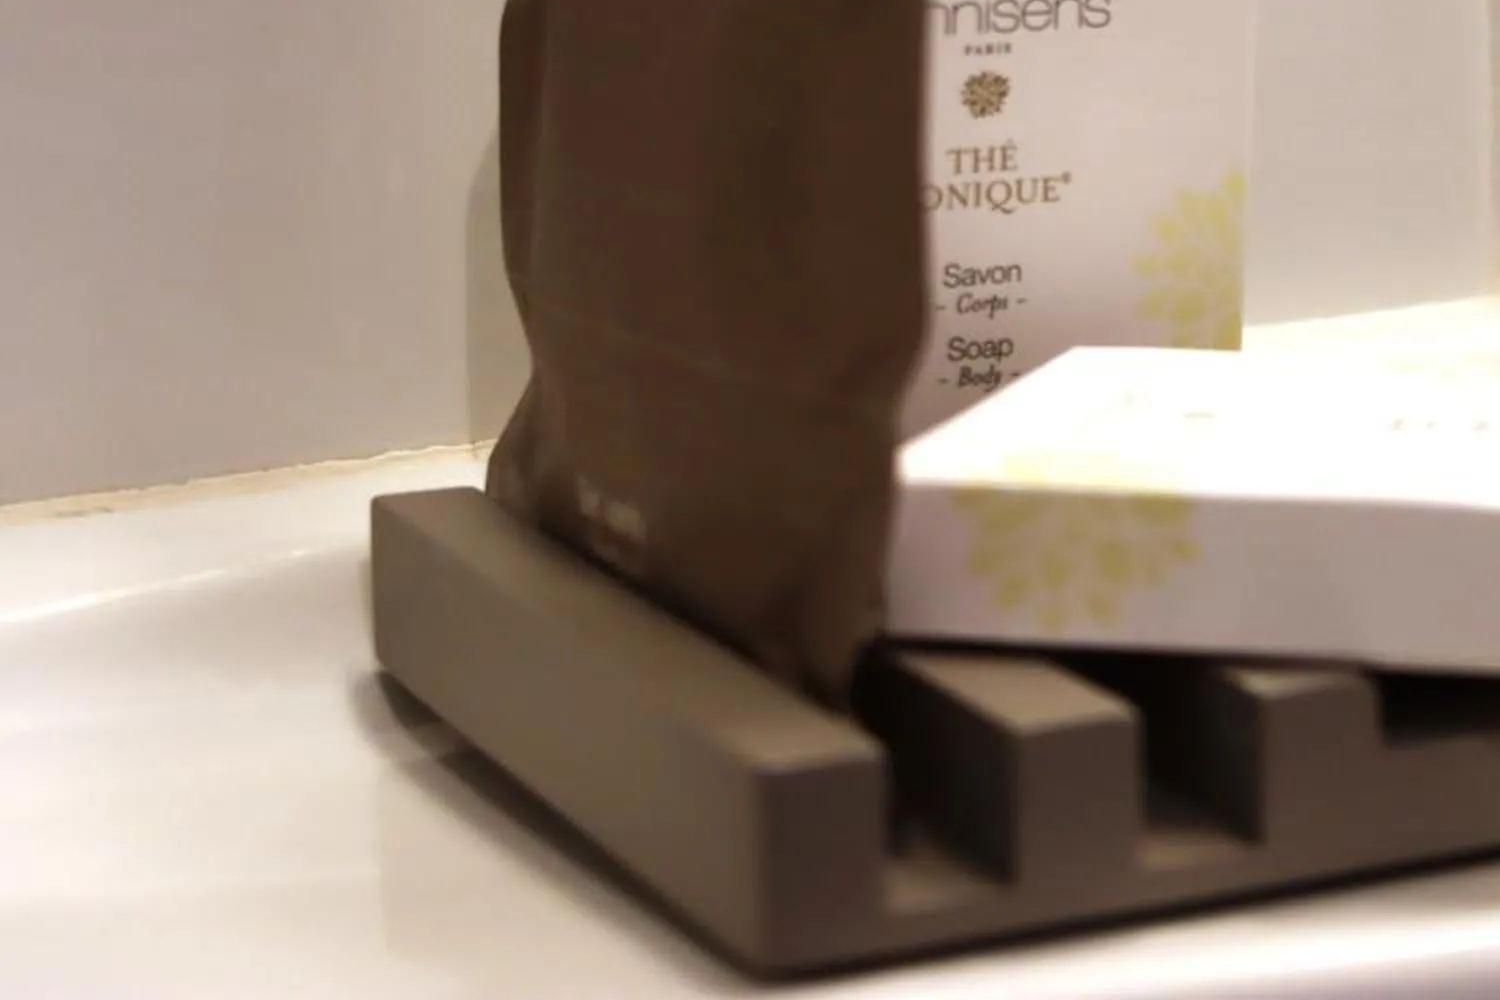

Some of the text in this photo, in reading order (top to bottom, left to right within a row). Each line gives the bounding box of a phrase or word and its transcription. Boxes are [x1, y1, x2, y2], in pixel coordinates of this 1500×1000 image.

[945, 139, 1018, 175] THÉ
[919, 175, 1061, 214] ONIQUE
[943, 263, 1022, 289] Savon
[956, 293, 1008, 319] Corps
[946, 336, 1015, 363] Soap
[957, 365, 1003, 393] Body
